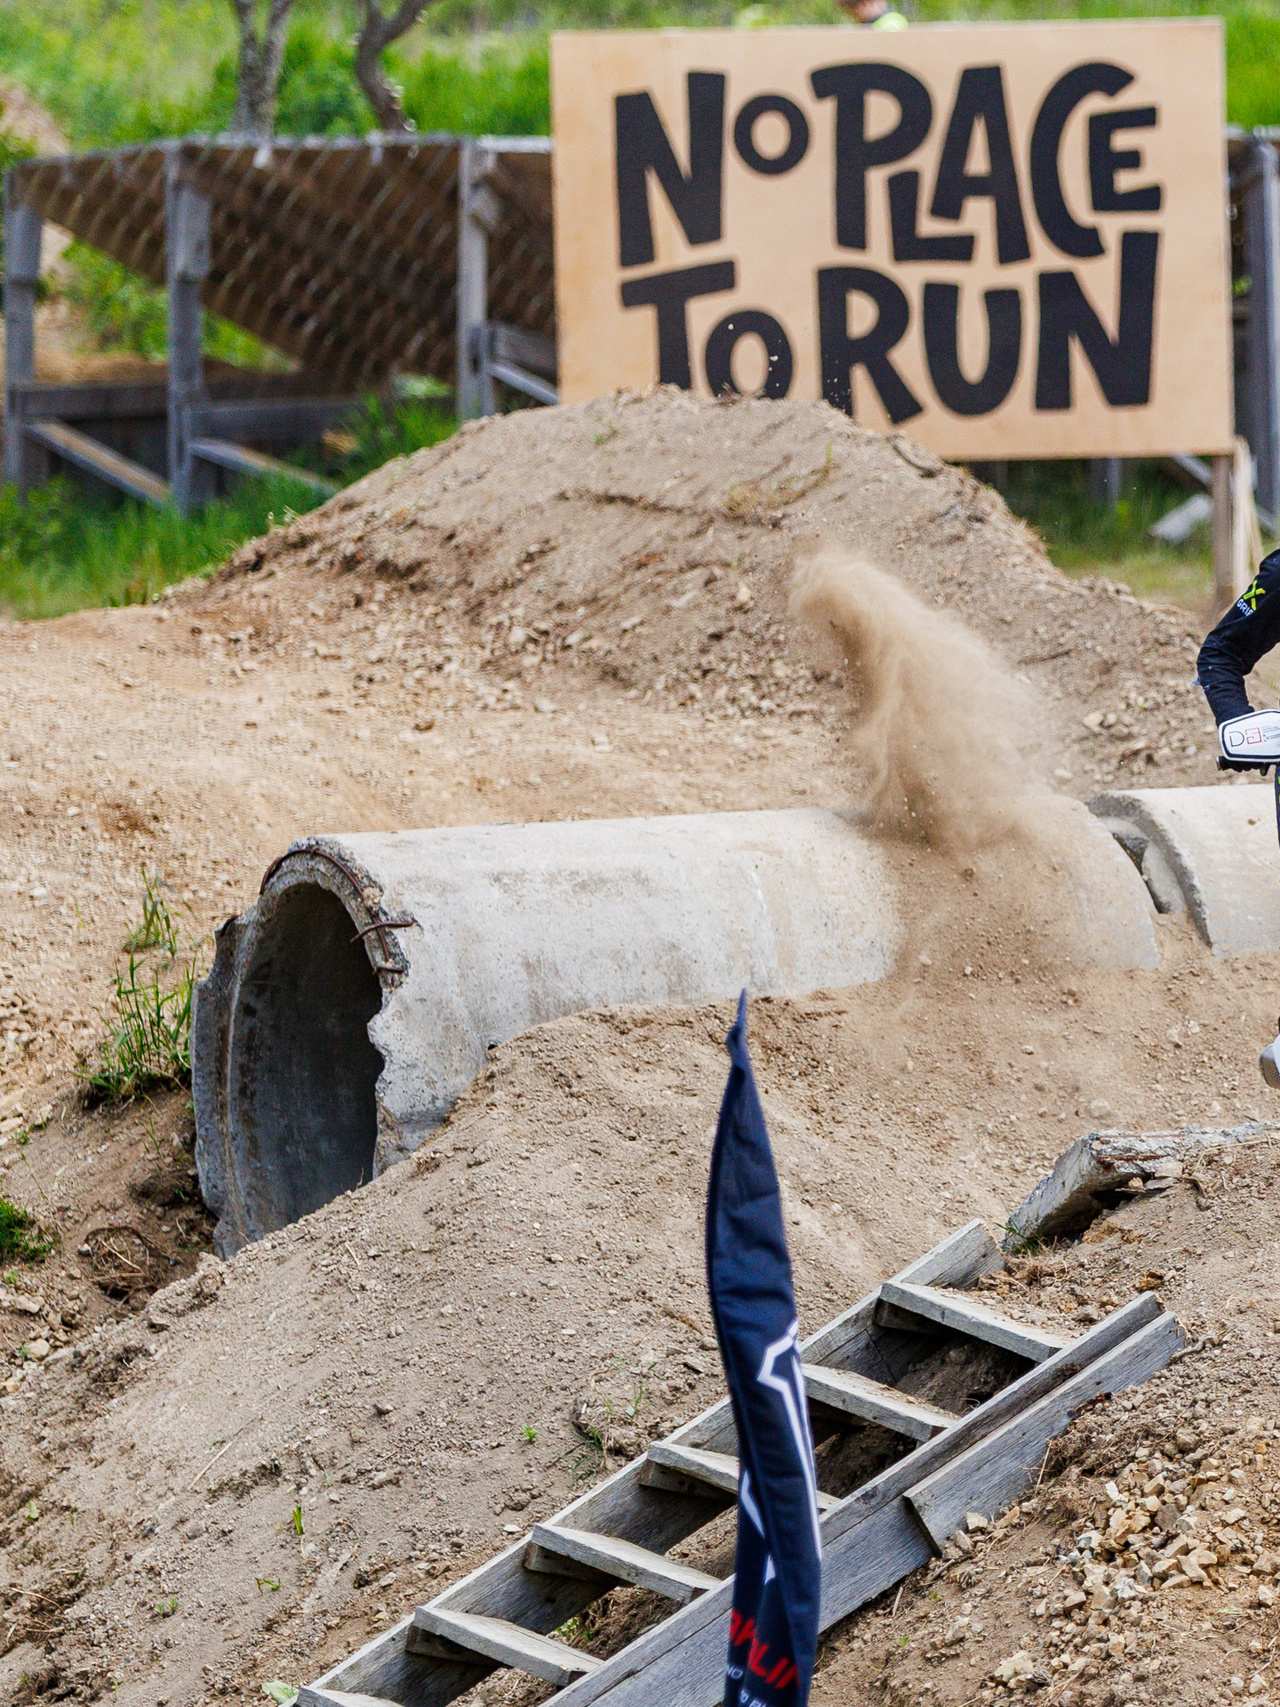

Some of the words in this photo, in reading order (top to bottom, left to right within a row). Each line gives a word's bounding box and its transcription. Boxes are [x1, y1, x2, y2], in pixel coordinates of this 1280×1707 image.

[615, 71, 811, 267] NO
[811, 61, 1162, 265] PLACE
[621, 260, 794, 400] TO
[818, 230, 1161, 425] RUN
